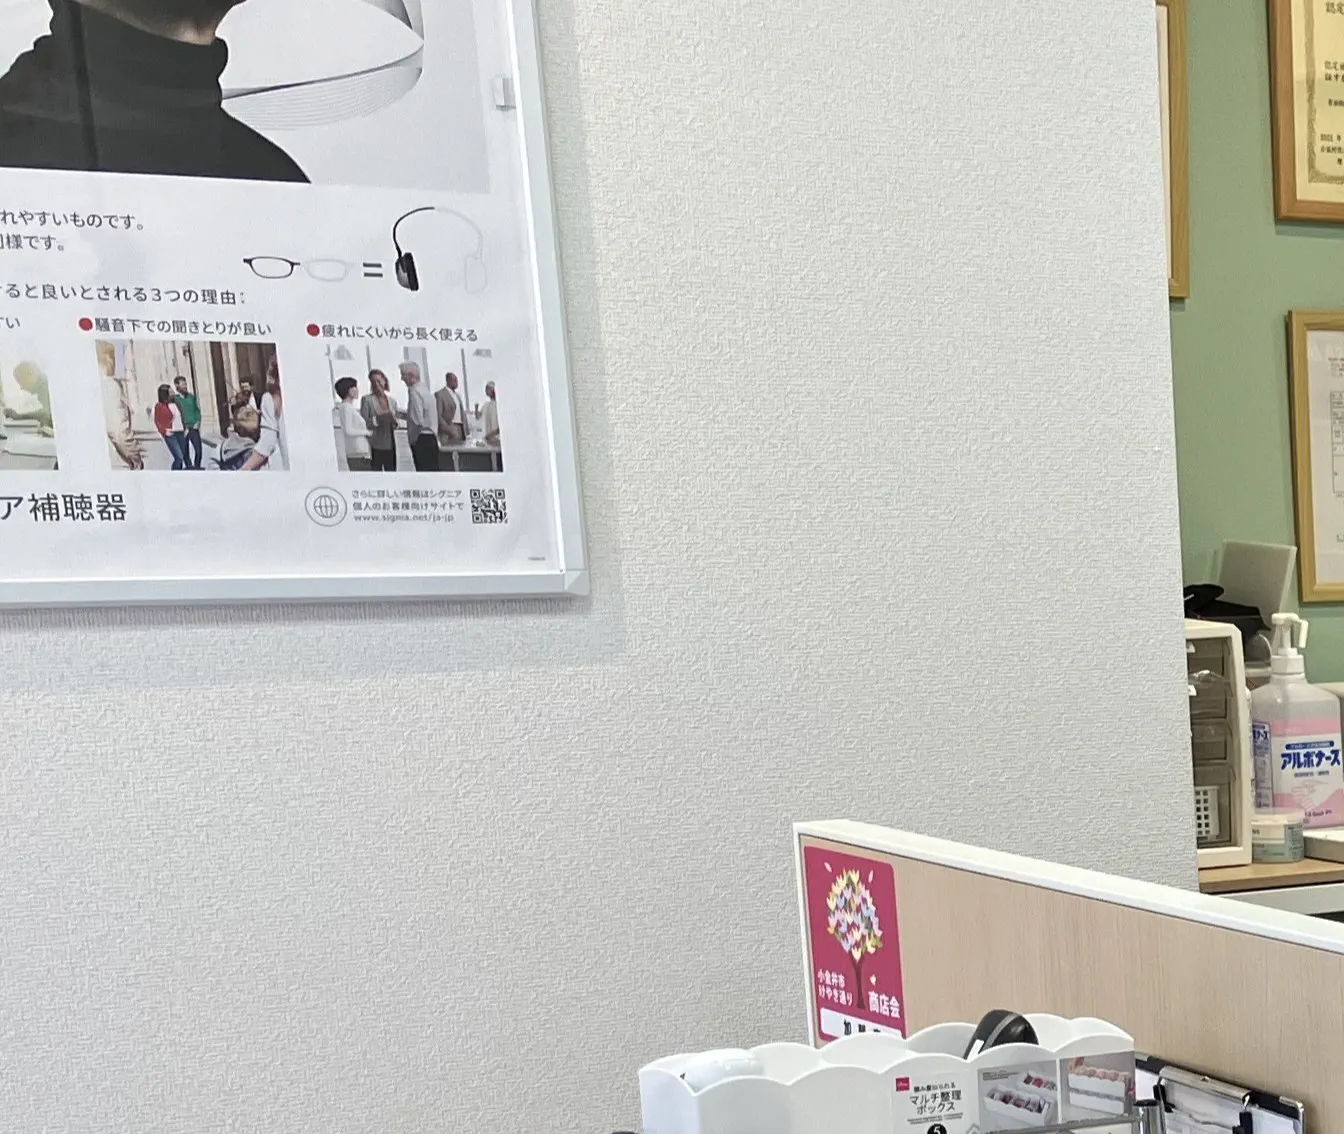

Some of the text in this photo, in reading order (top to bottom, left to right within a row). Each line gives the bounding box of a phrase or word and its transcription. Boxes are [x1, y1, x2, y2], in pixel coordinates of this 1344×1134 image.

[0, 234, 65, 251] 様です。
[0, 284, 246, 305] ると良いとされる3つの理由:
[95, 317, 272, 336] 騒音下での聞きとりが良い
[322, 323, 478, 342] 疲れにくいから長く使える
[1281, 749, 1341, 770] アルボナース
[818, 968, 846, 988] 小金井市
[819, 985, 853, 1006] けやき通り
[869, 991, 901, 1019] 商店会
[909, 1090, 962, 1105] マルチ整理
[916, 1101, 956, 1116] ボックス
